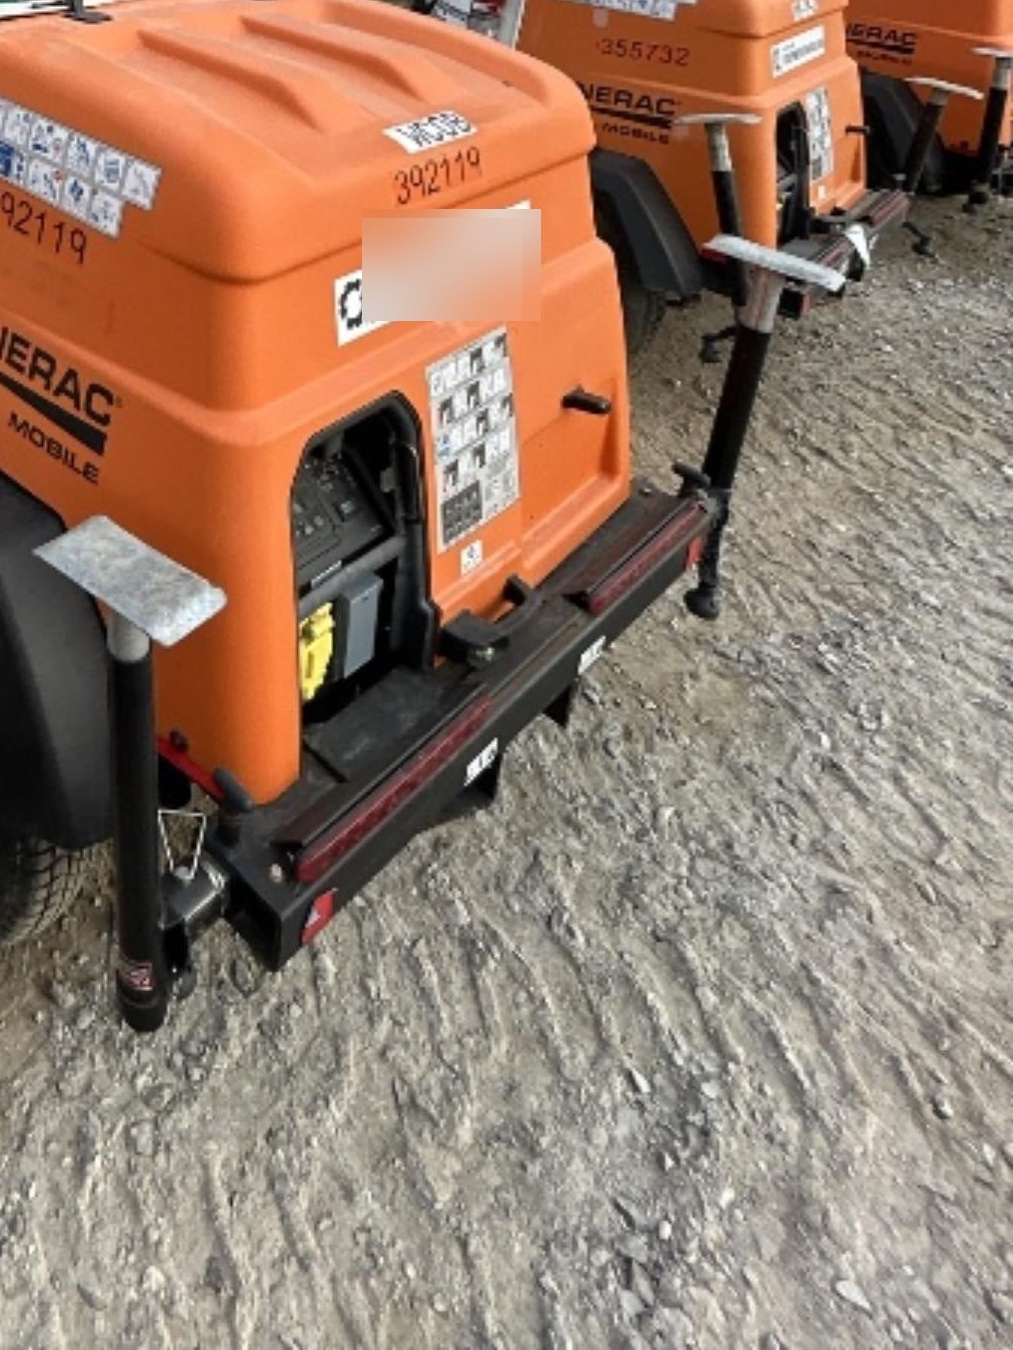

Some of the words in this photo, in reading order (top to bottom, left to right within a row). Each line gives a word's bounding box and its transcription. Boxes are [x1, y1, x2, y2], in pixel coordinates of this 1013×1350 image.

[600, 37, 691, 68] 355732
[394, 146, 484, 206] 392119
[6, 409, 101, 485] MOBILE
